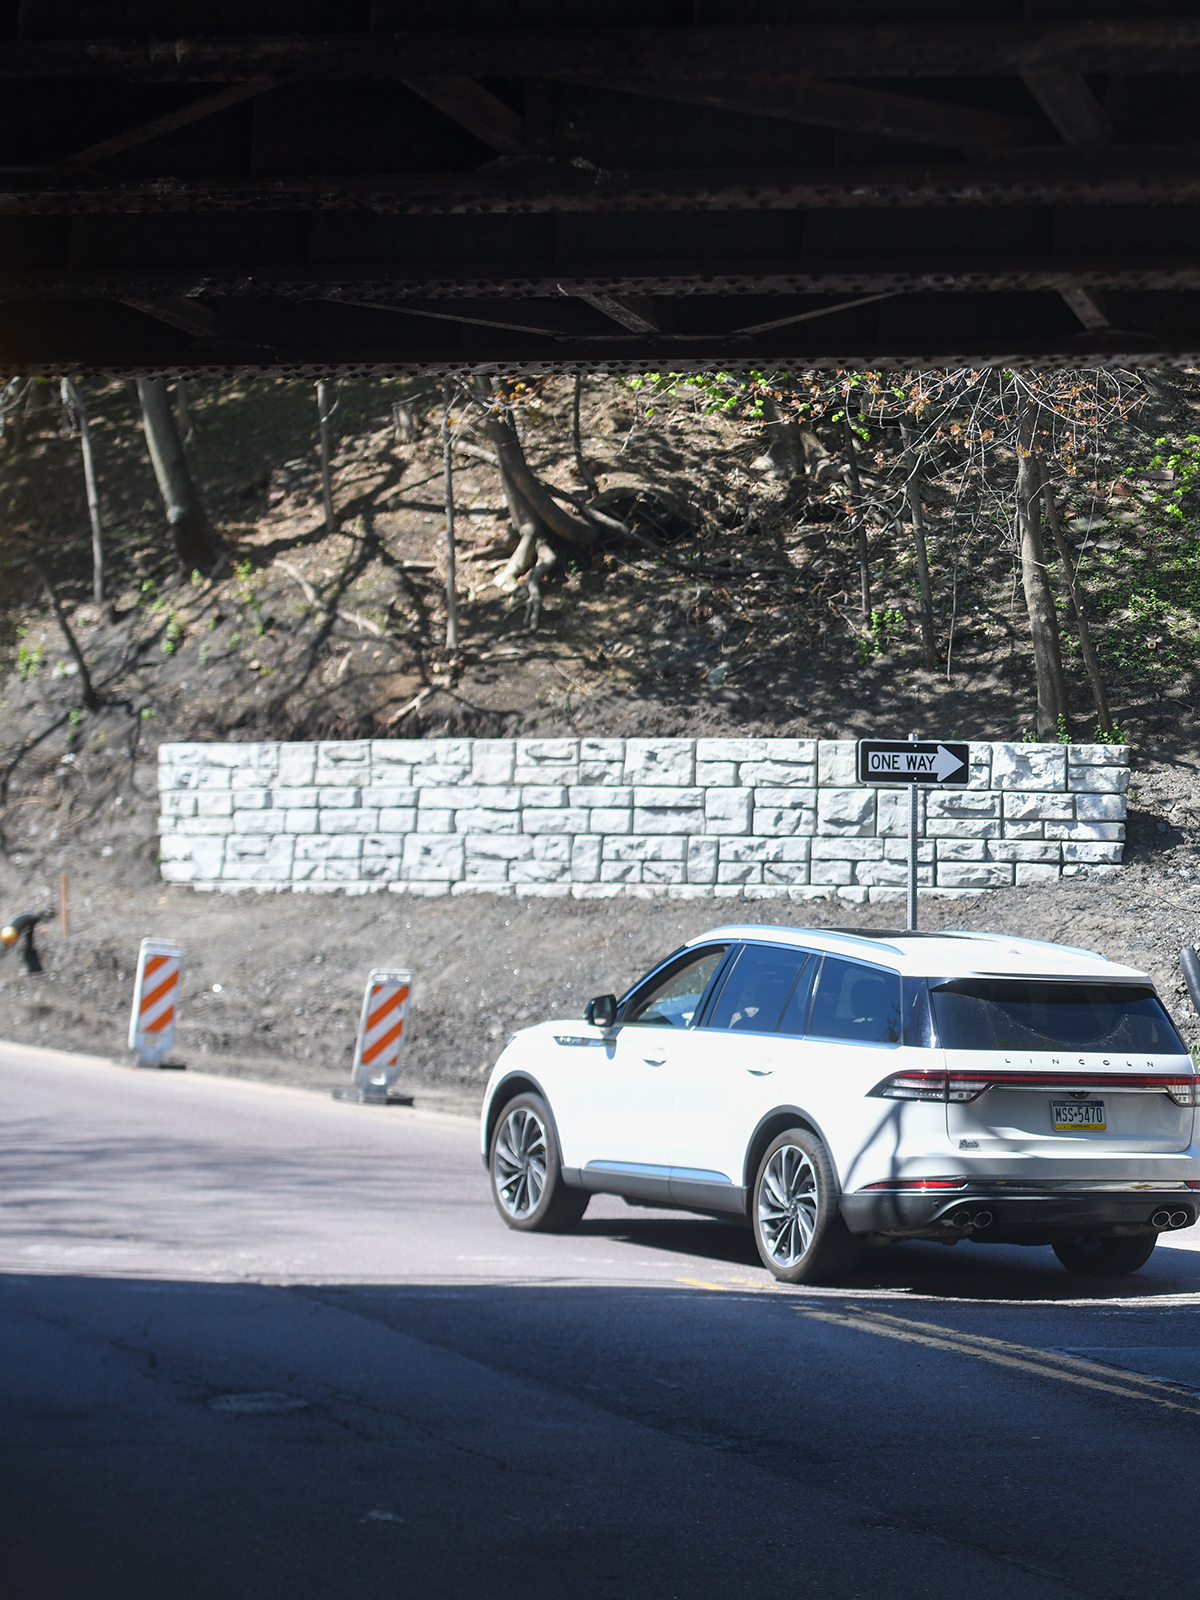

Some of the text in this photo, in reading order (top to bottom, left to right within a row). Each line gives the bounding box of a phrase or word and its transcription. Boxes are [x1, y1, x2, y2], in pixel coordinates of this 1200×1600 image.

[871, 754, 936, 771] ONE WAY
[1004, 1058, 1154, 1068] LINCOLN
